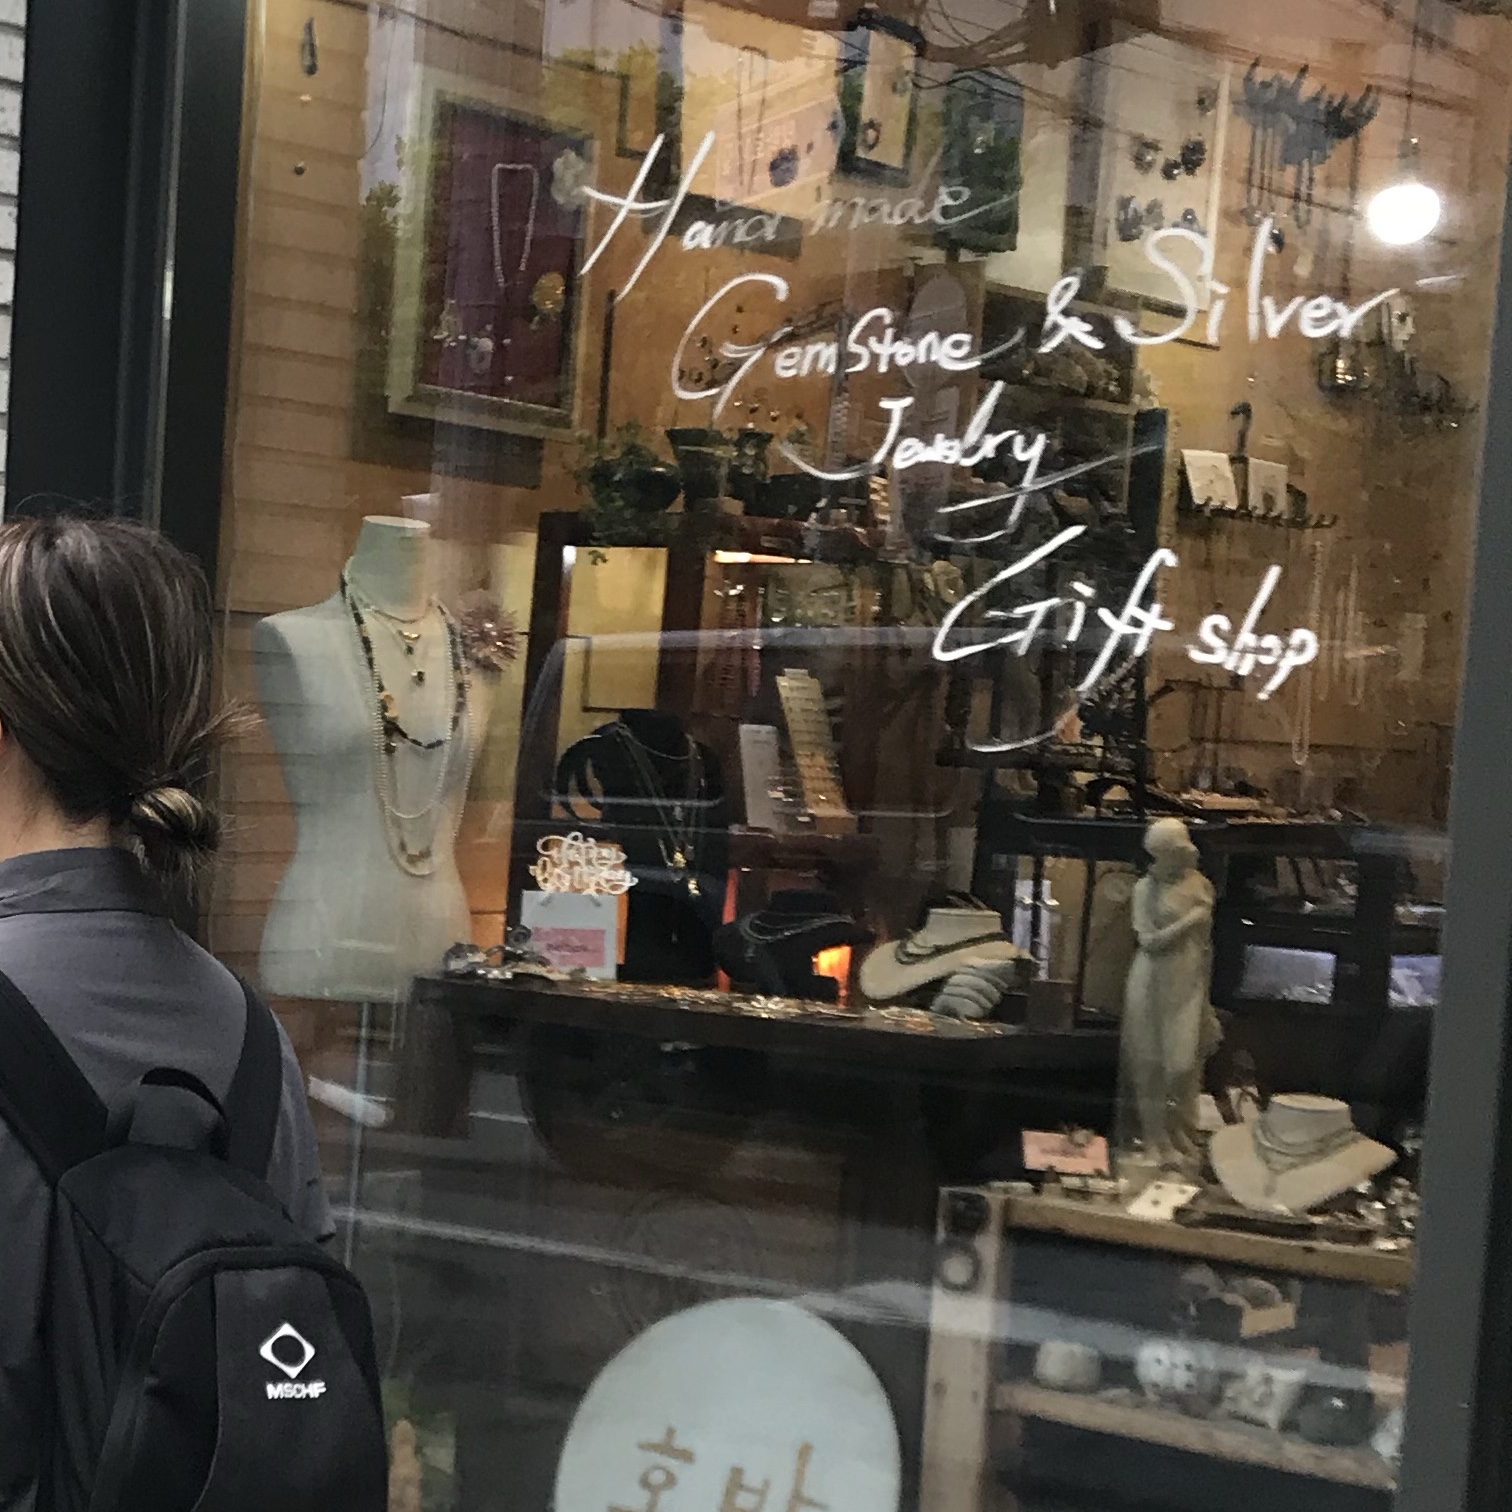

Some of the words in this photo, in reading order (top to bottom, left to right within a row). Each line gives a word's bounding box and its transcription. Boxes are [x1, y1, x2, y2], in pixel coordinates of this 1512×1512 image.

[1038, 272, 1105, 353] &
[1113, 218, 1400, 345] Silver
[933, 525, 1180, 752] Gift
[1186, 564, 1320, 701] shop
